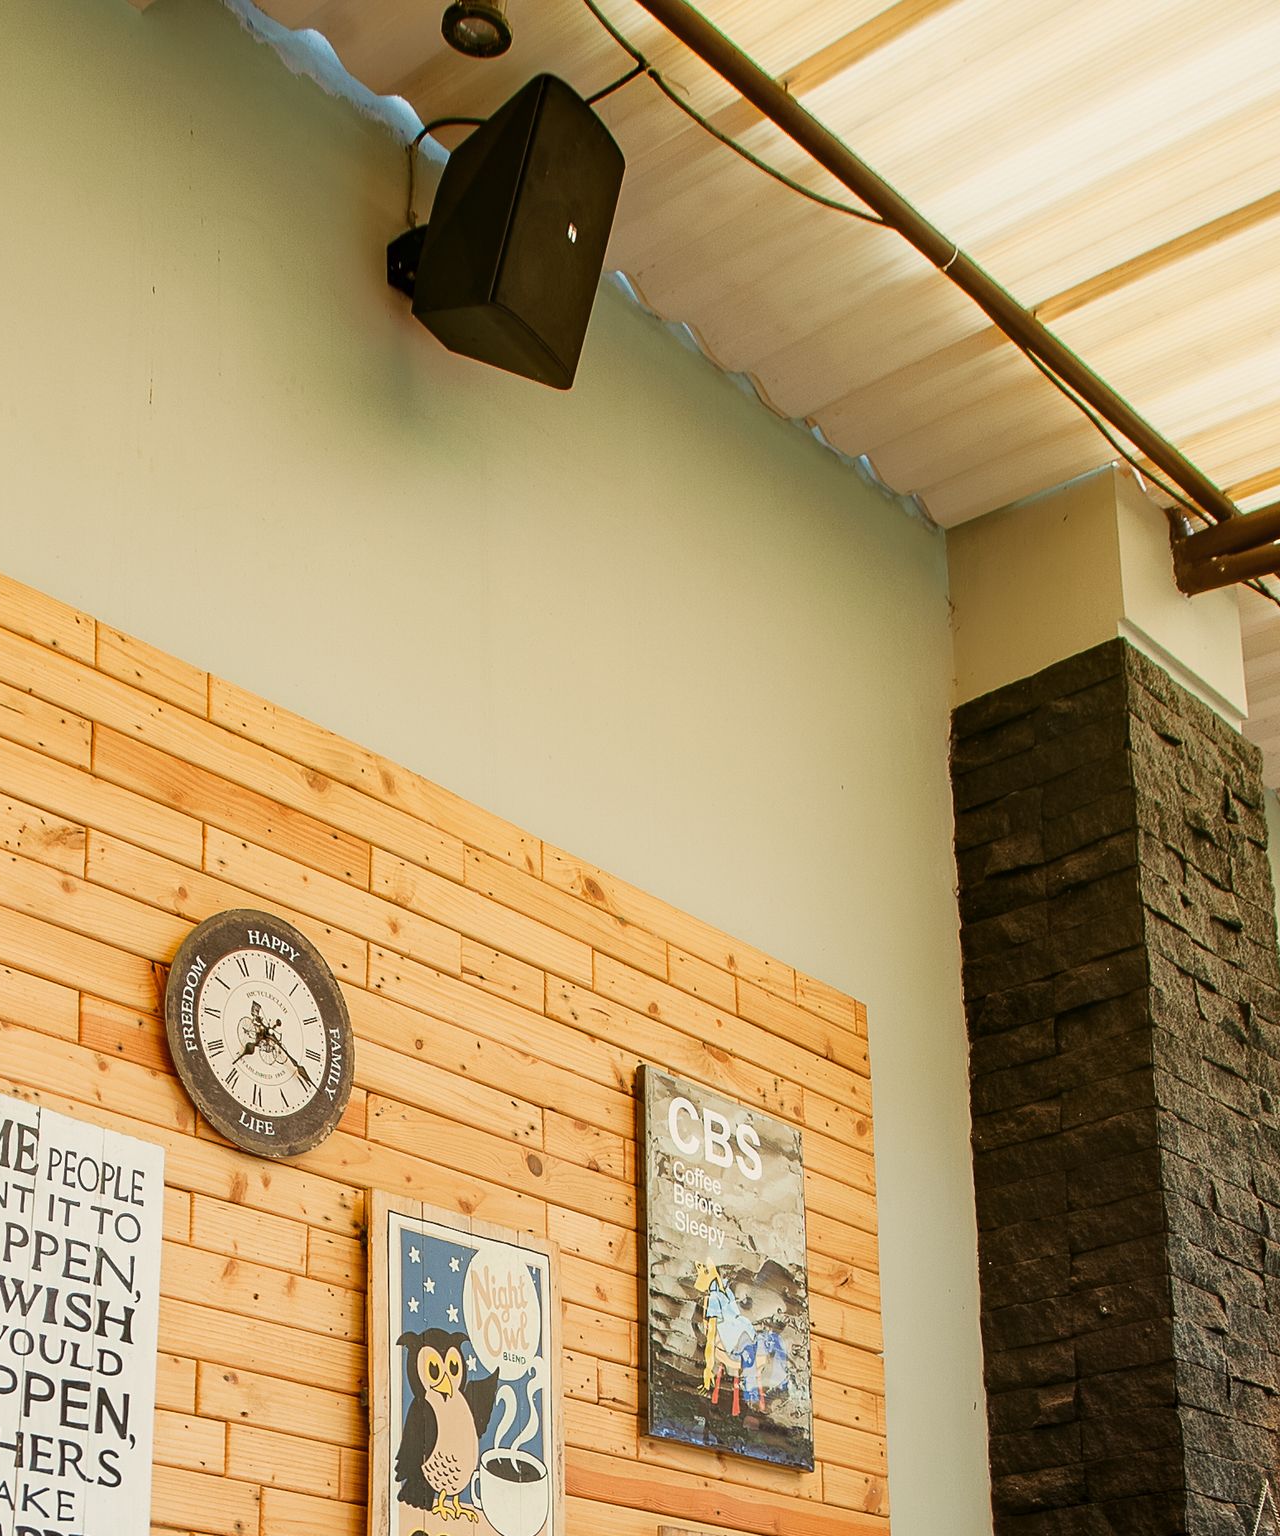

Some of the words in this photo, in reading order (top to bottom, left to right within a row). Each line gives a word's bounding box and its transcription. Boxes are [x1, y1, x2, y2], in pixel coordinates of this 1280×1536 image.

[247, 930, 301, 963] HAPPY
[180, 954, 207, 1052] FREEDOM
[324, 1027, 340, 1101] FAMILY
[238, 1111, 276, 1136] LIFE
[667, 1096, 764, 1181] CBS
[46, 1147, 145, 1207] PEOPLE
[672, 1161, 722, 1196] Coffee
[47, 1194, 81, 1227] IT
[91, 1206, 142, 1243] TO
[672, 1185, 722, 1219] Before
[674, 1210, 726, 1250] Sleepy
[470, 1263, 529, 1336] Night
[482, 1318, 531, 1359] Owl
[502, 1350, 527, 1366] BLEND
